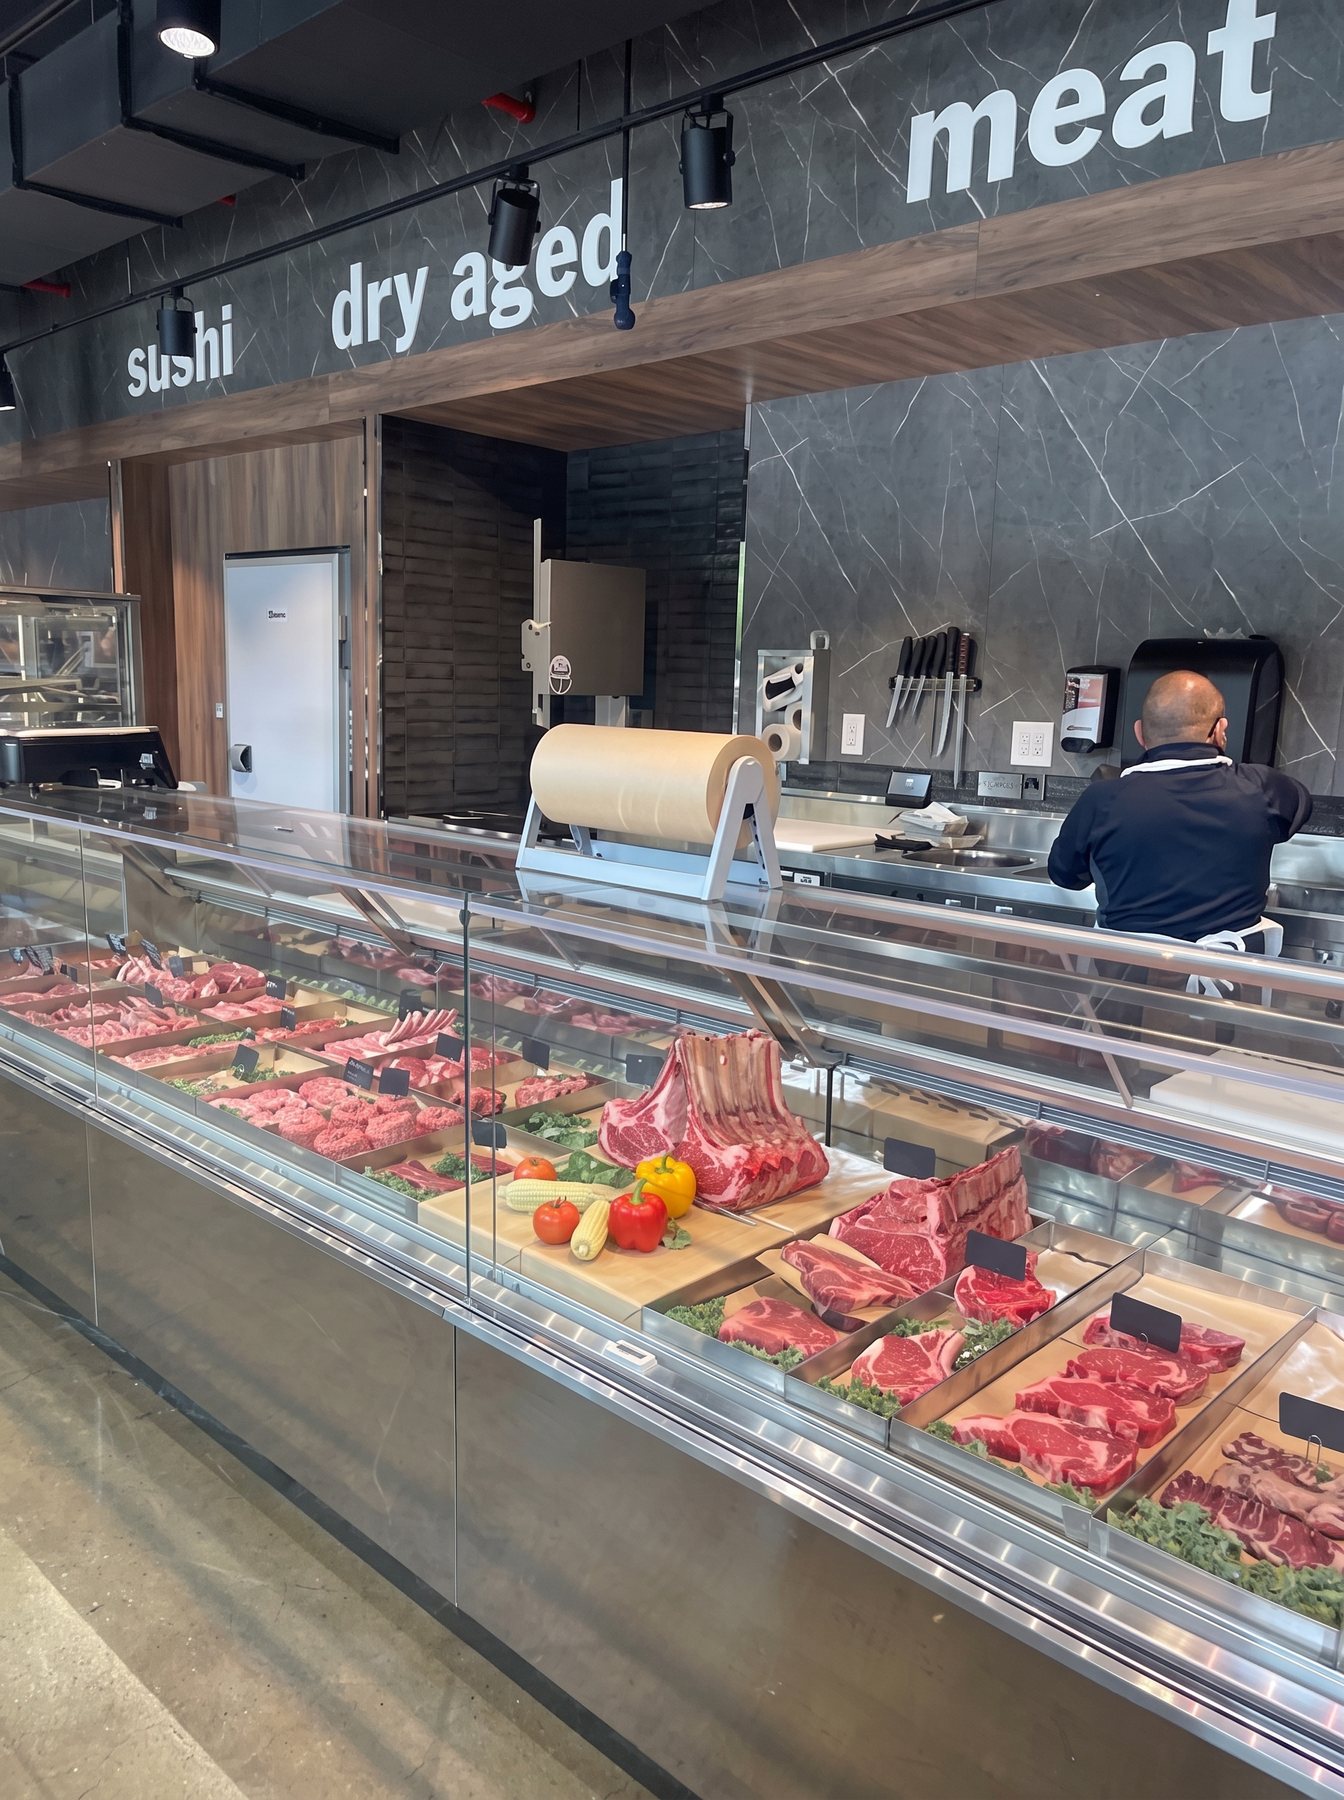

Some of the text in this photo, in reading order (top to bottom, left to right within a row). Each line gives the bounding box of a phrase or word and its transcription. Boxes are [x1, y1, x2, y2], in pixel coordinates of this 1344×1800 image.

[906, 0, 1277, 204] meat
[127, 303, 234, 398] sushi
[331, 177, 624, 353] dry aged
